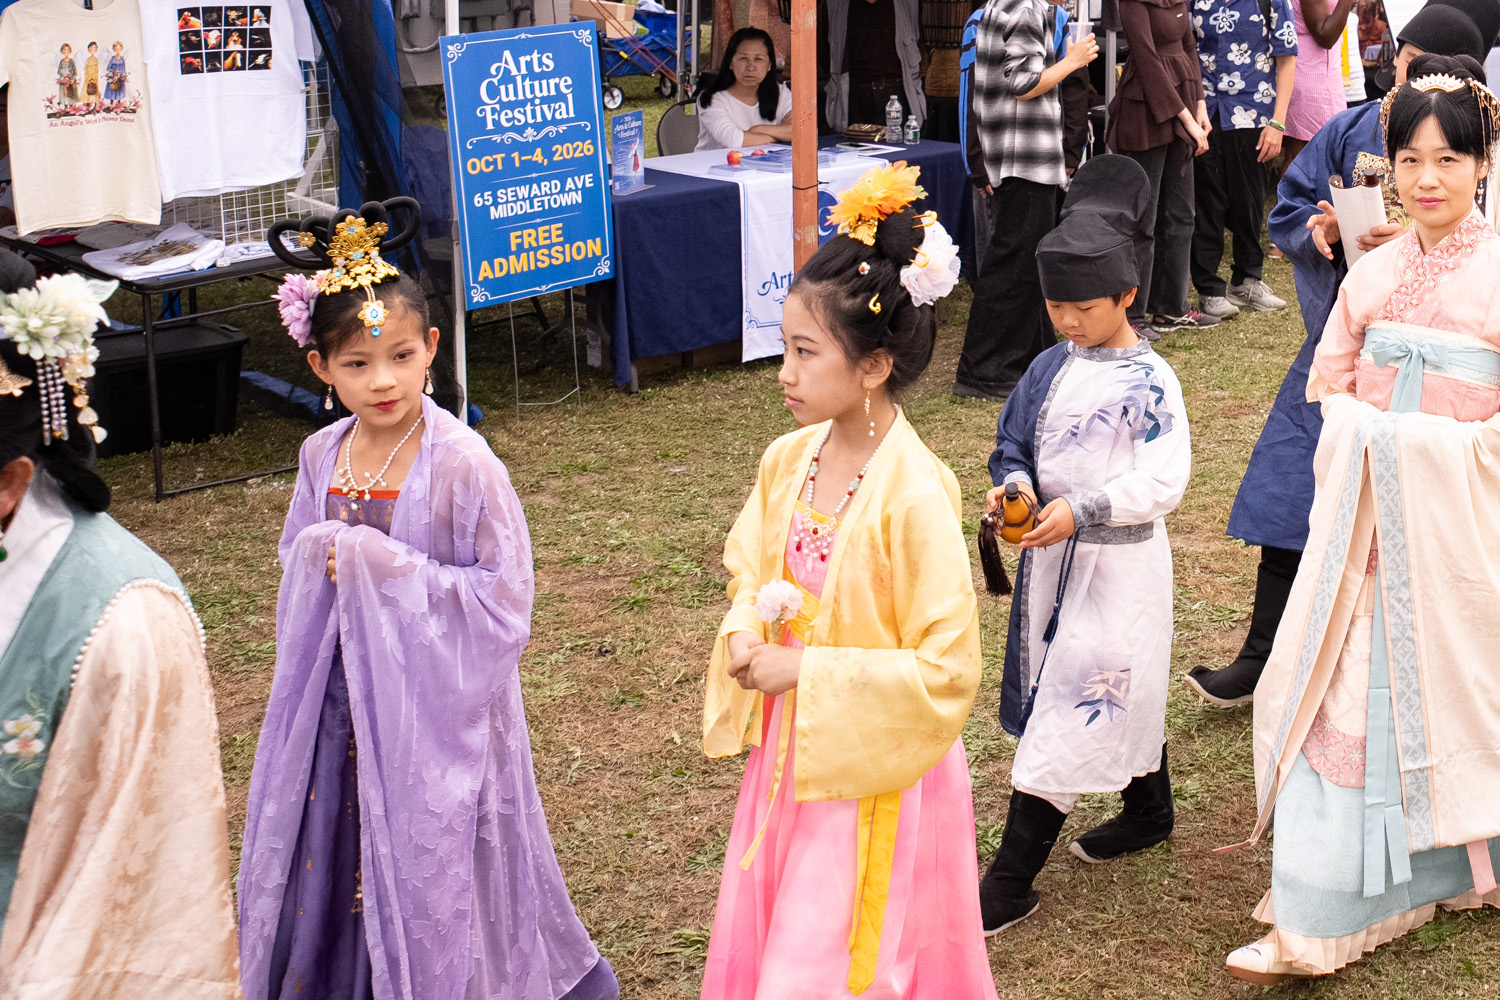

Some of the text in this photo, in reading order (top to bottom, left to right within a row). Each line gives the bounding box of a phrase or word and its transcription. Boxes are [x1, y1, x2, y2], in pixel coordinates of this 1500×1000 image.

[490, 50, 555, 79] Arts
[480, 75, 573, 104] Culture
[476, 93, 576, 130] Festival
[467, 154, 506, 174] OCT
[552, 140, 594, 161] 2026
[474, 173, 595, 207] 65 SEWARD AVE
[489, 190, 583, 220] MIDDLETOWN
[510, 223, 564, 251] FREE
[478, 237, 602, 282] ADMISSION
